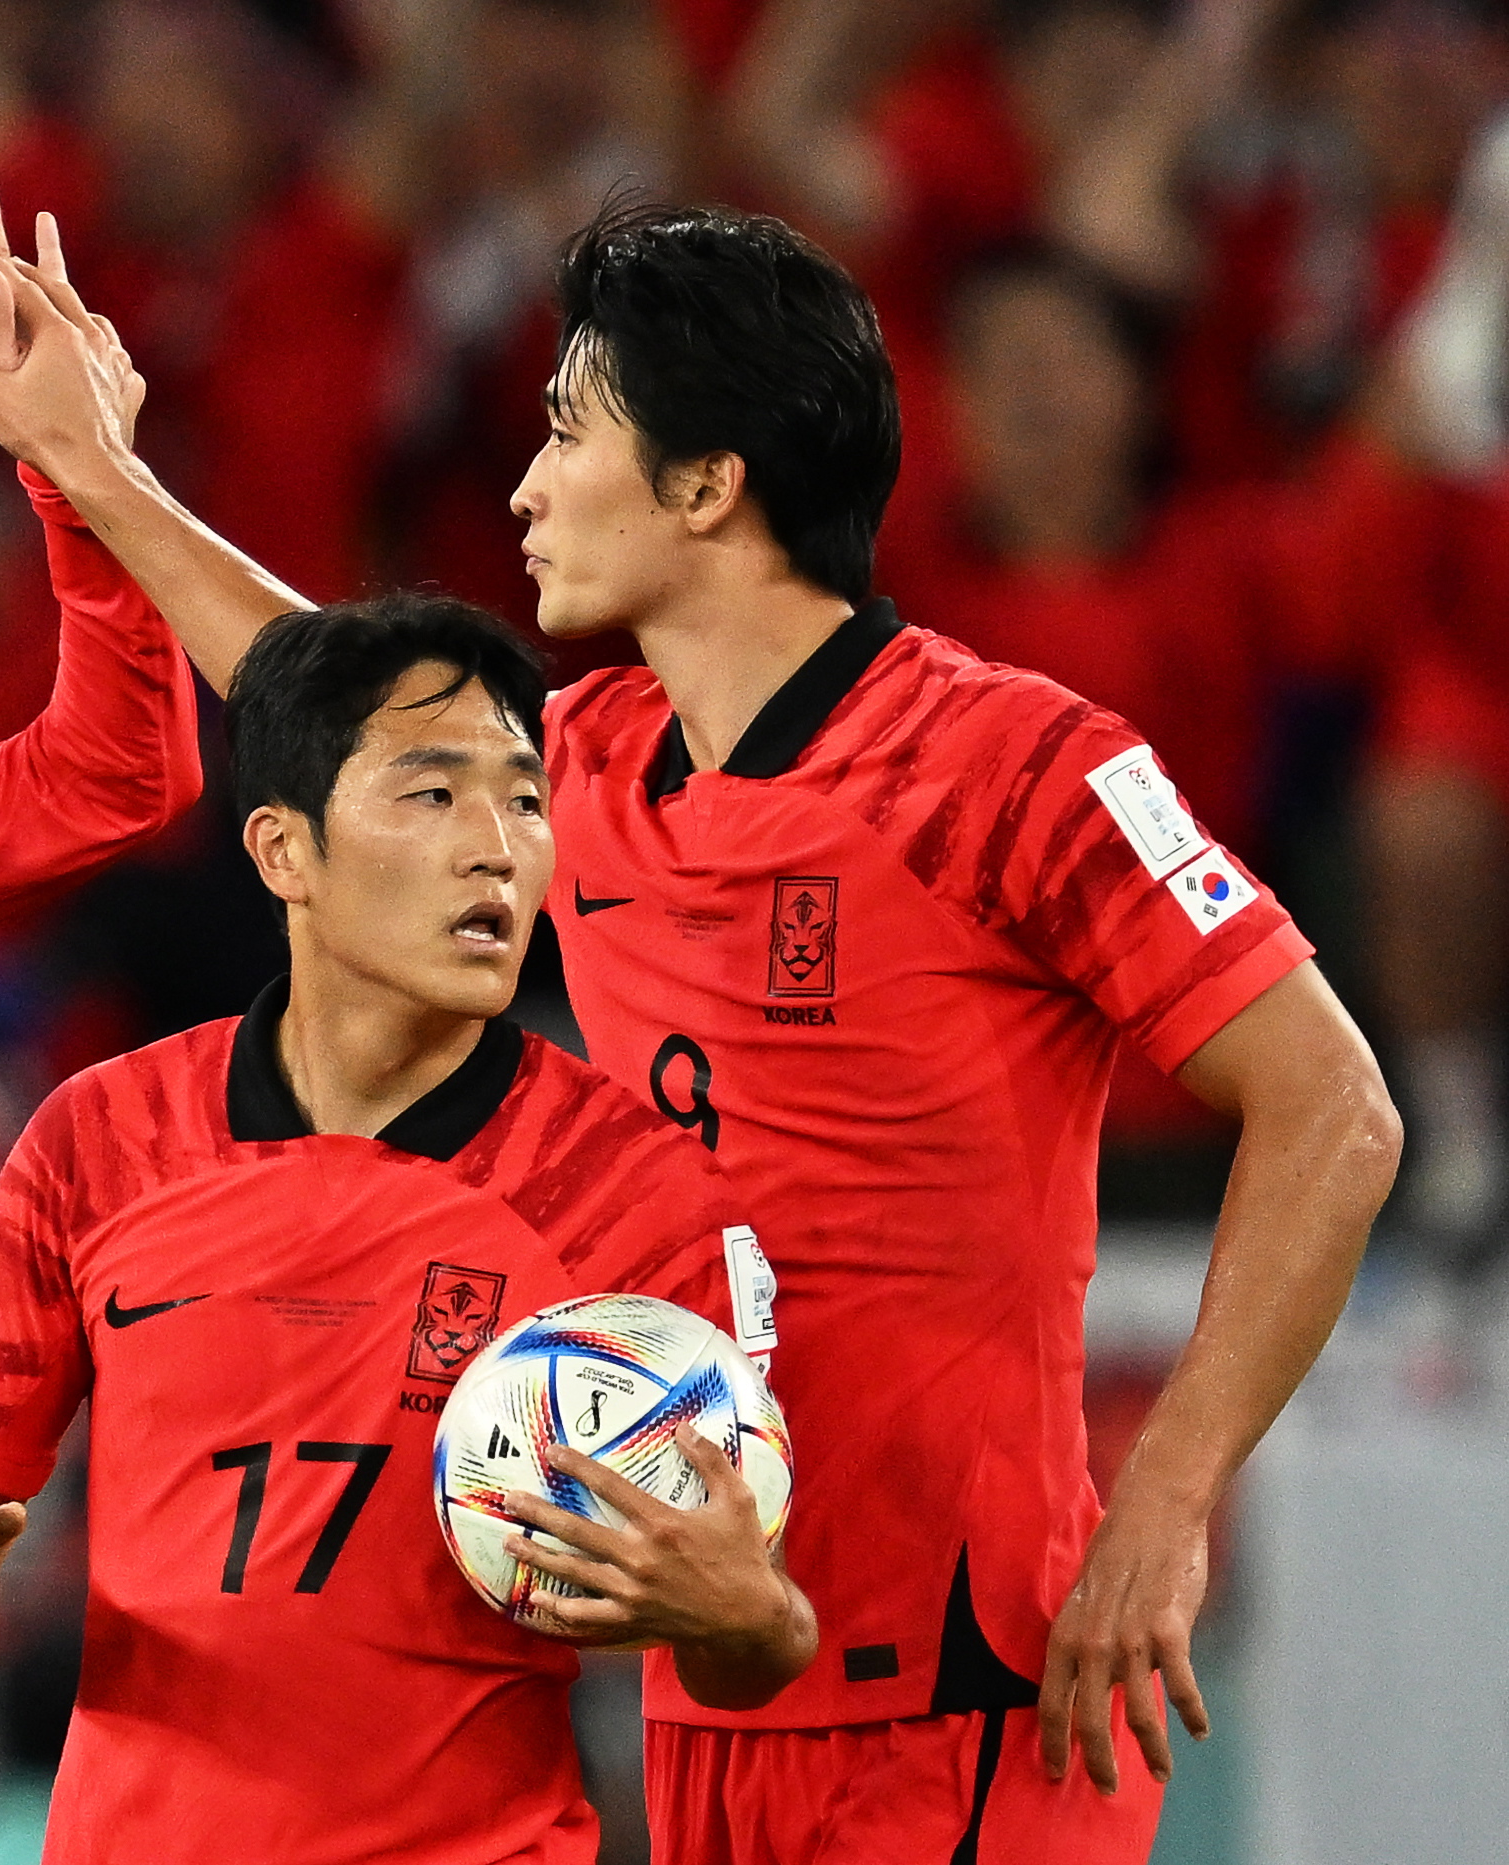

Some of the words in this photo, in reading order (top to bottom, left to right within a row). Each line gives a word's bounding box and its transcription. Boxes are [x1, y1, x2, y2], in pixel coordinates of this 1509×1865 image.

[764, 1006, 836, 1026] KOREA
[649, 1032, 720, 1154] 9
[399, 1390, 449, 1414] KOR
[668, 1469, 691, 1503] RIHLA
[211, 1441, 392, 1595] 17
